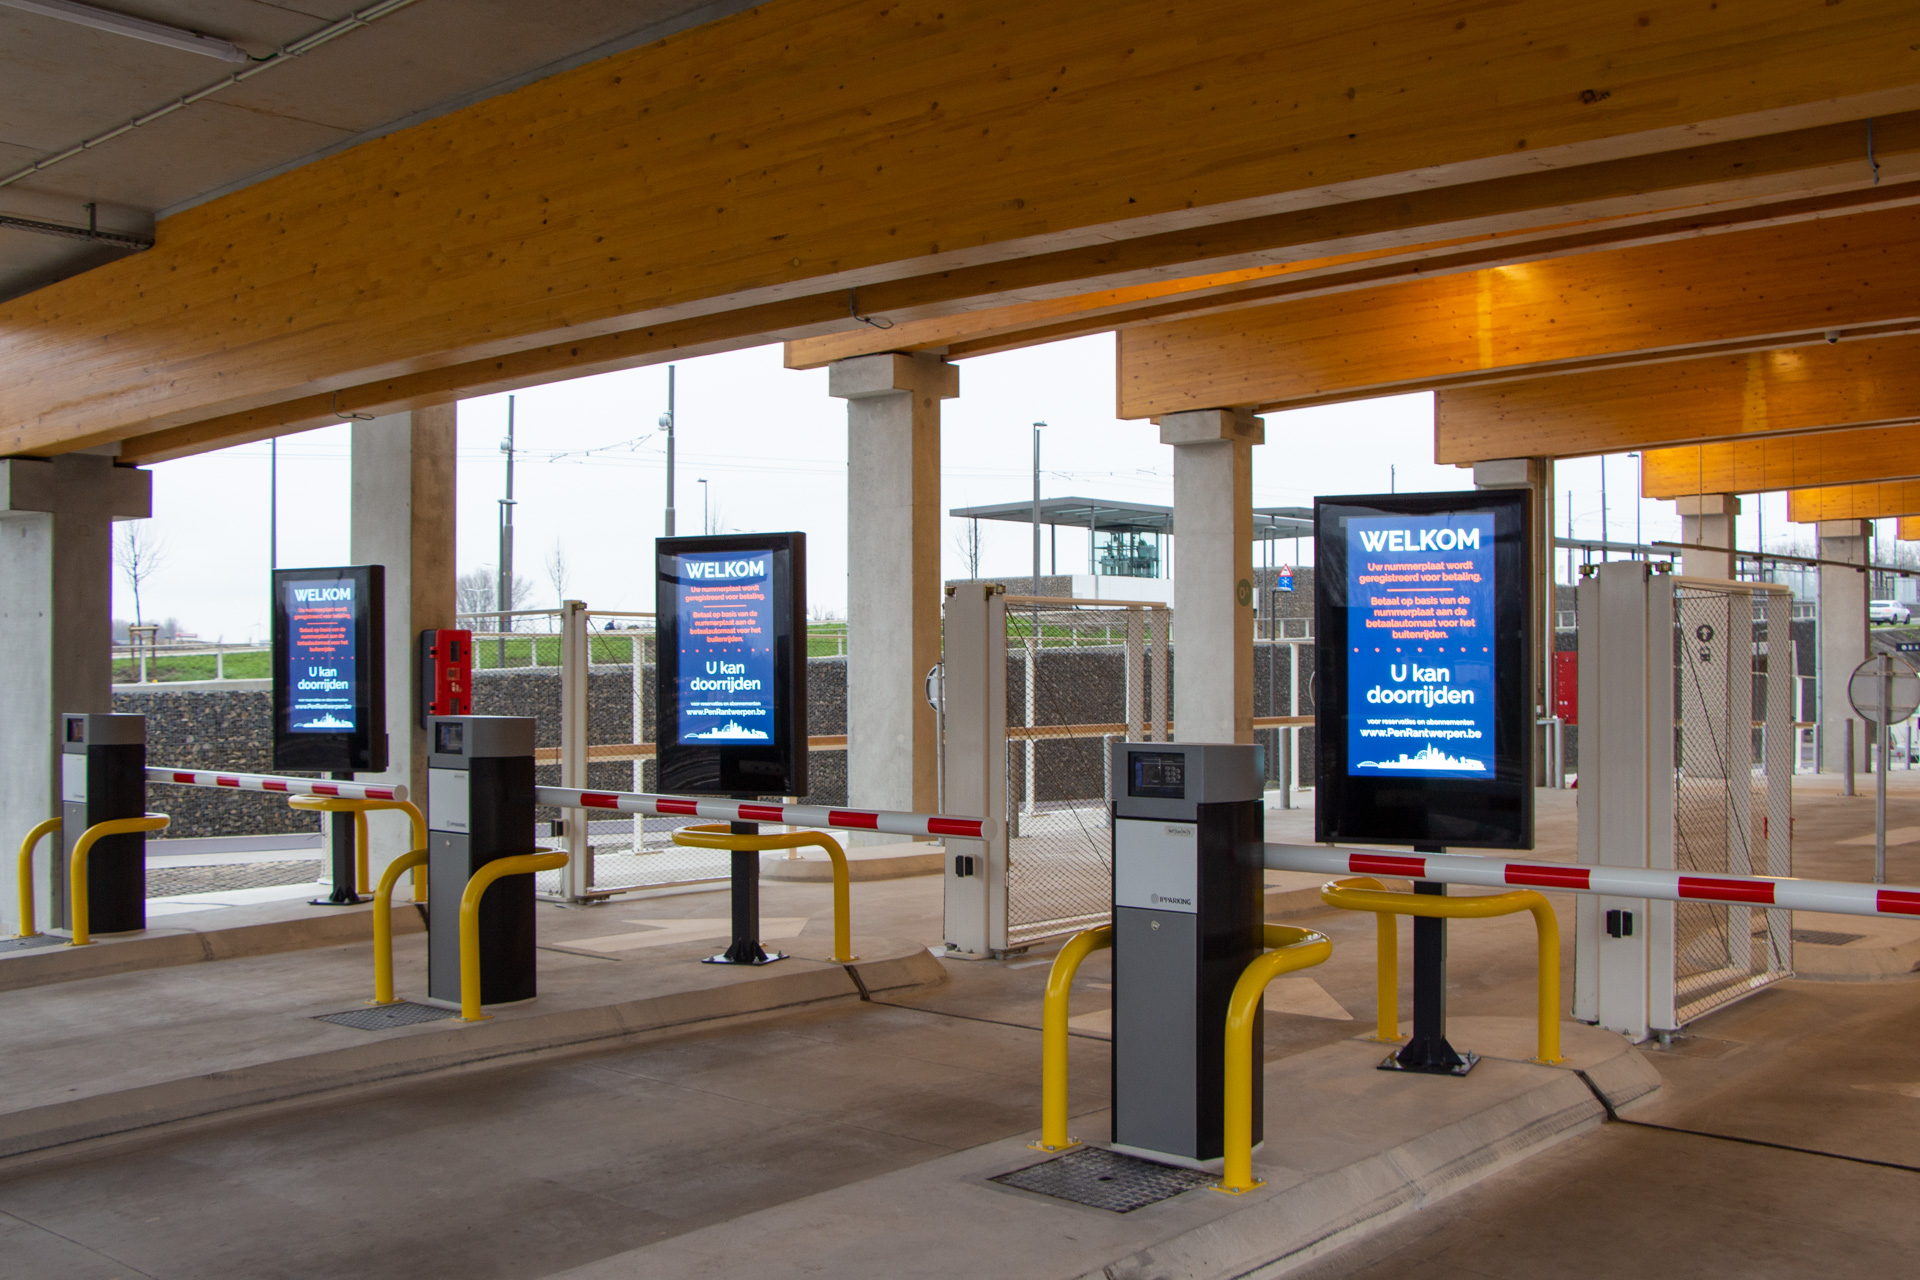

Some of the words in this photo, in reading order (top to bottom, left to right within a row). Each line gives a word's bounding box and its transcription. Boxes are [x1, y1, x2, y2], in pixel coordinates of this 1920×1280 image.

[1359, 528, 1480, 552] WELKOM
[685, 560, 764, 579] WELKOM
[1367, 563, 1383, 571] Uw
[1384, 561, 1445, 572] nummerplaat
[1446, 561, 1473, 570] wordt
[1359, 573, 1419, 584] geregistreerd
[1442, 572, 1482, 583] betaling.
[294, 587, 351, 602] WELKOM
[1371, 596, 1400, 606] Betaal
[1401, 598, 1413, 607] op
[1415, 596, 1438, 605] basis
[1439, 597, 1456, 605] van
[1457, 595, 1470, 604] de
[1374, 607, 1434, 618] nummerplaat
[1435, 608, 1453, 616] aan
[1454, 607, 1468, 616] de
[1366, 618, 1437, 628] betaalautomaat
[1438, 619, 1458, 627] voor
[1459, 618, 1476, 627] het
[1392, 630, 1448, 640] buitenrijden.
[308, 666, 318, 677] U
[318, 666, 338, 677] kan
[706, 661, 717, 675] U
[720, 660, 745, 675] kan
[1391, 663, 1407, 682] U
[1412, 663, 1450, 682] kan
[297, 679, 349, 692] doorrijden
[690, 676, 761, 693] doorrijden
[1366, 685, 1474, 708] doorrijden
[686, 707, 766, 717] www.PenRantwerpen.be
[1426, 718, 1475, 726] abonnementen
[1359, 727, 1482, 740] www.PenRantwerpen.be
